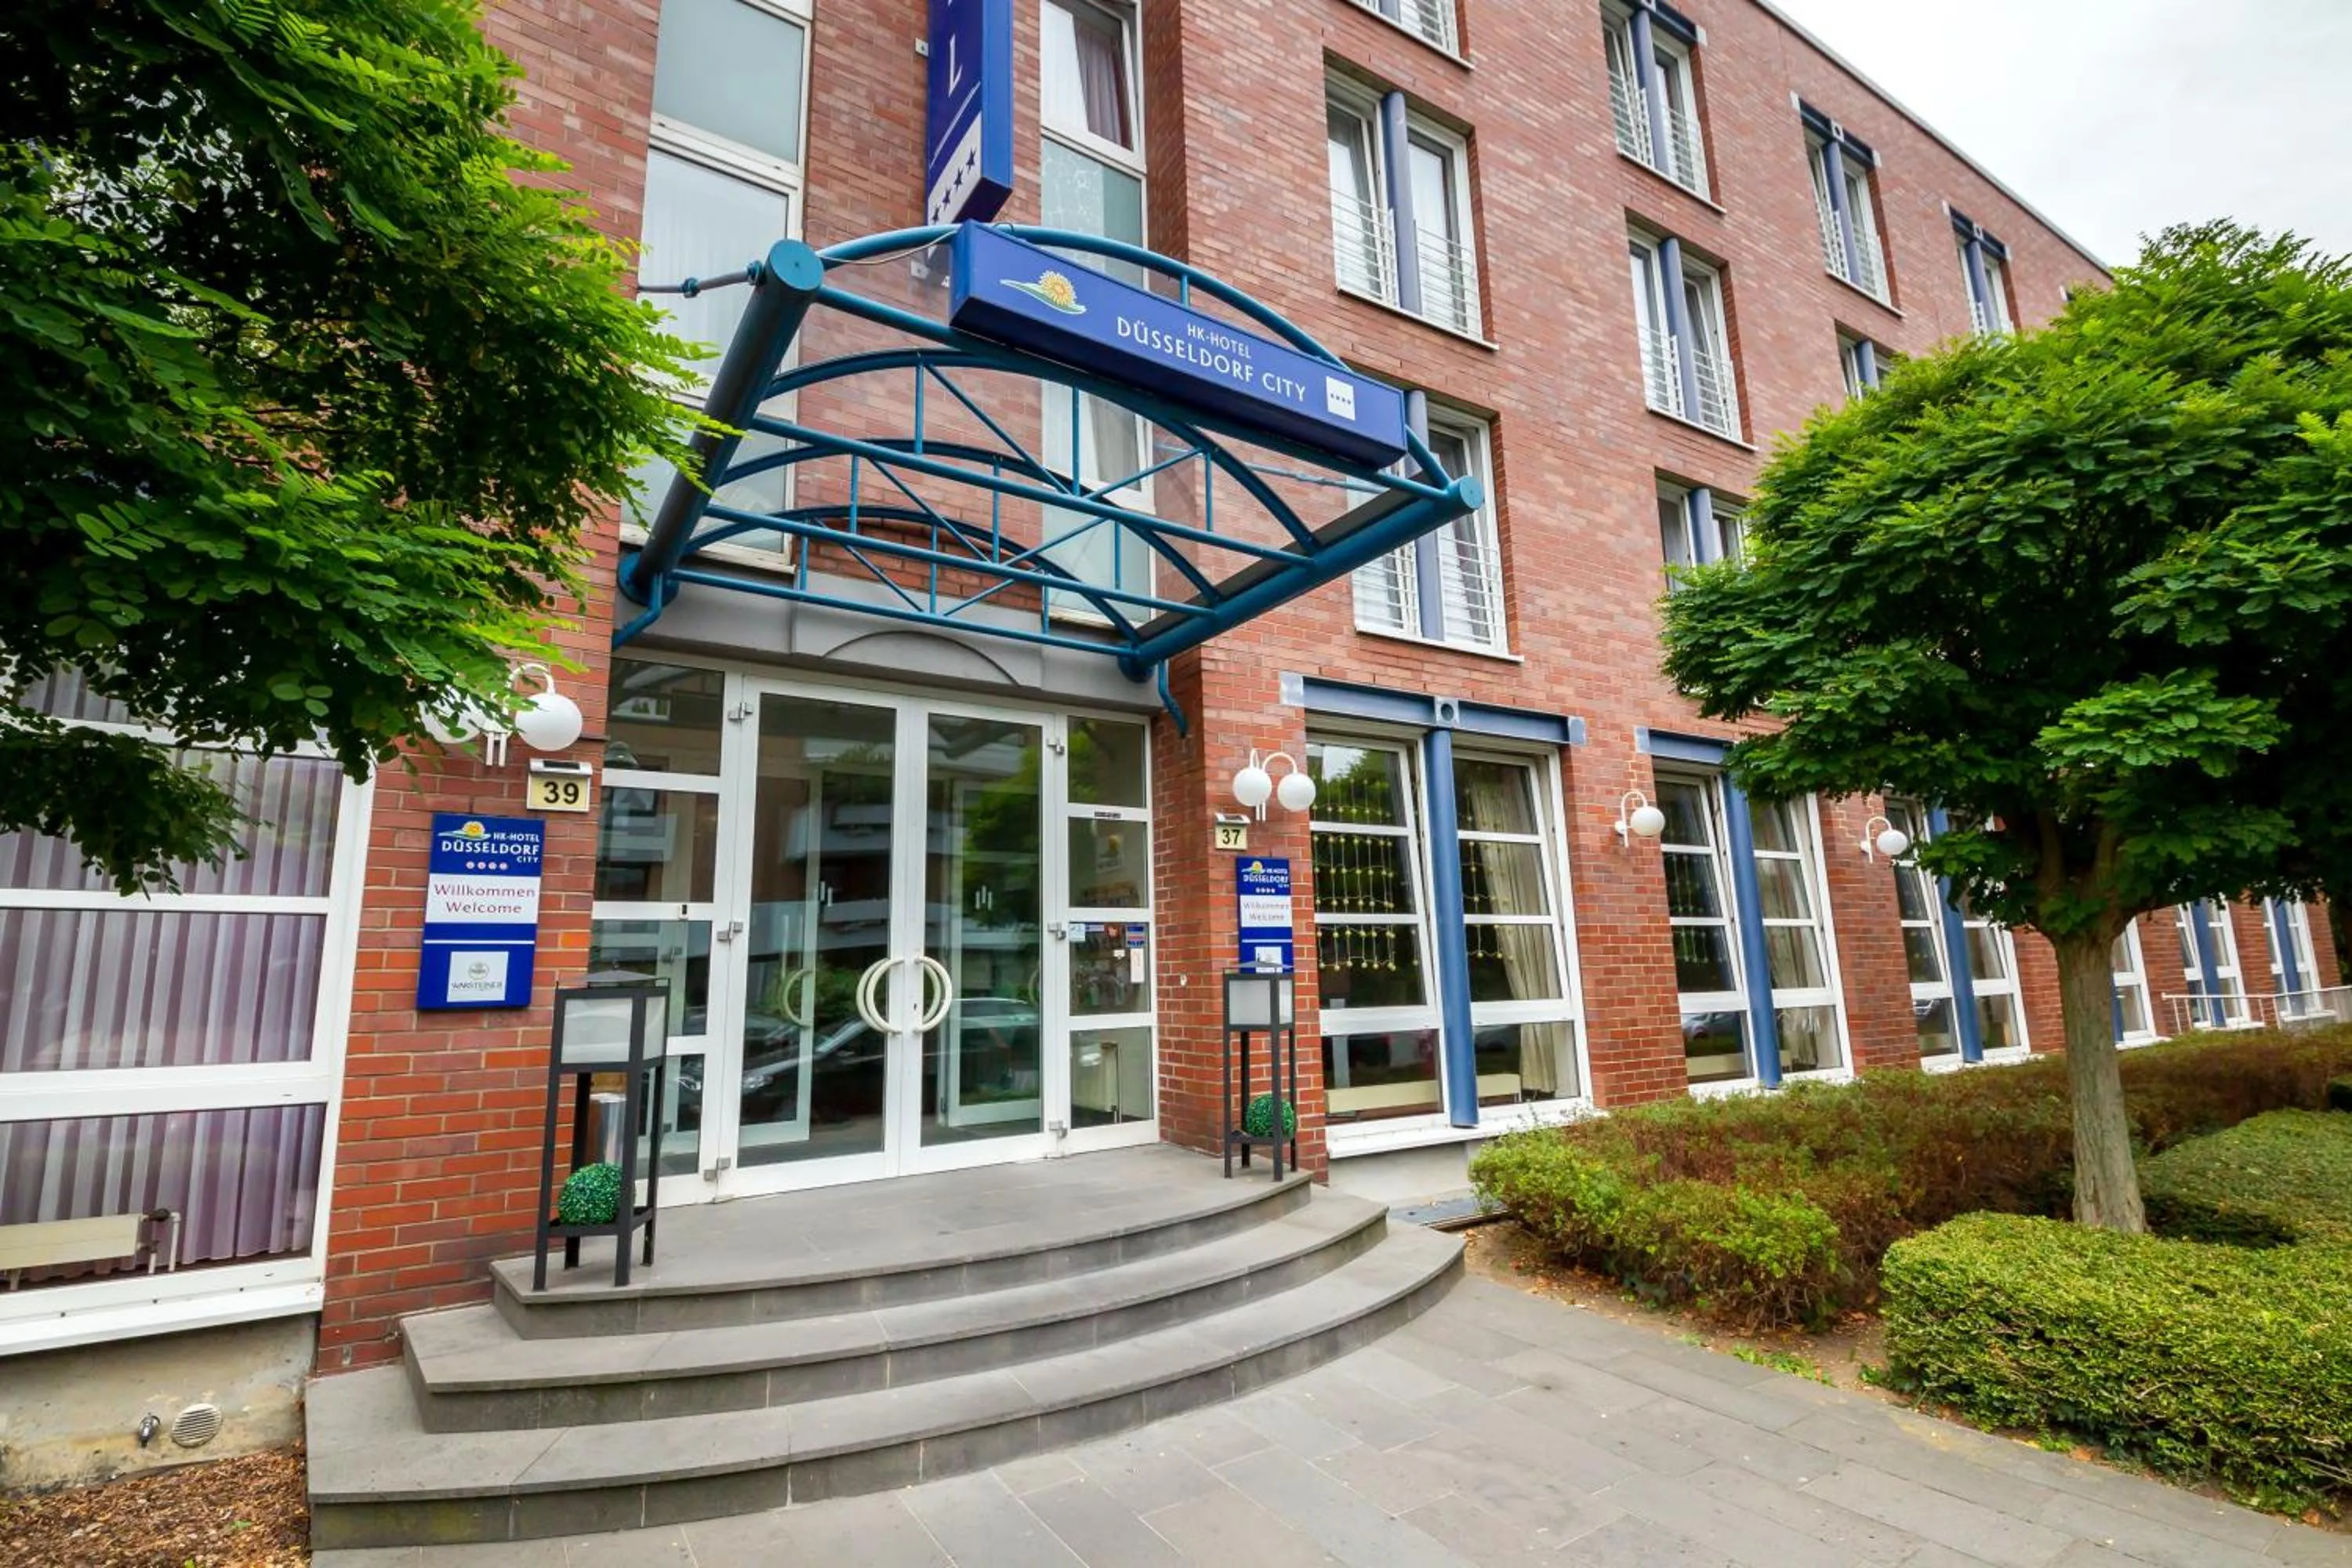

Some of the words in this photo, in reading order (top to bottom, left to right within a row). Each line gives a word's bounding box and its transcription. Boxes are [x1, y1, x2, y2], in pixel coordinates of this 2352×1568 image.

[1187, 322, 1252, 359] HK-HOTEL
[1116, 315, 1254, 383] DÜSSELDORF
[1261, 372, 1306, 402] CITY
[543, 781, 579, 805] 39
[492, 831, 540, 843] HK-HOTEL
[1222, 829, 1241, 845] 37
[441, 839, 540, 855] DÜSSELDORF
[434, 883, 535, 898] Willkommen
[445, 901, 523, 914] Welcome
